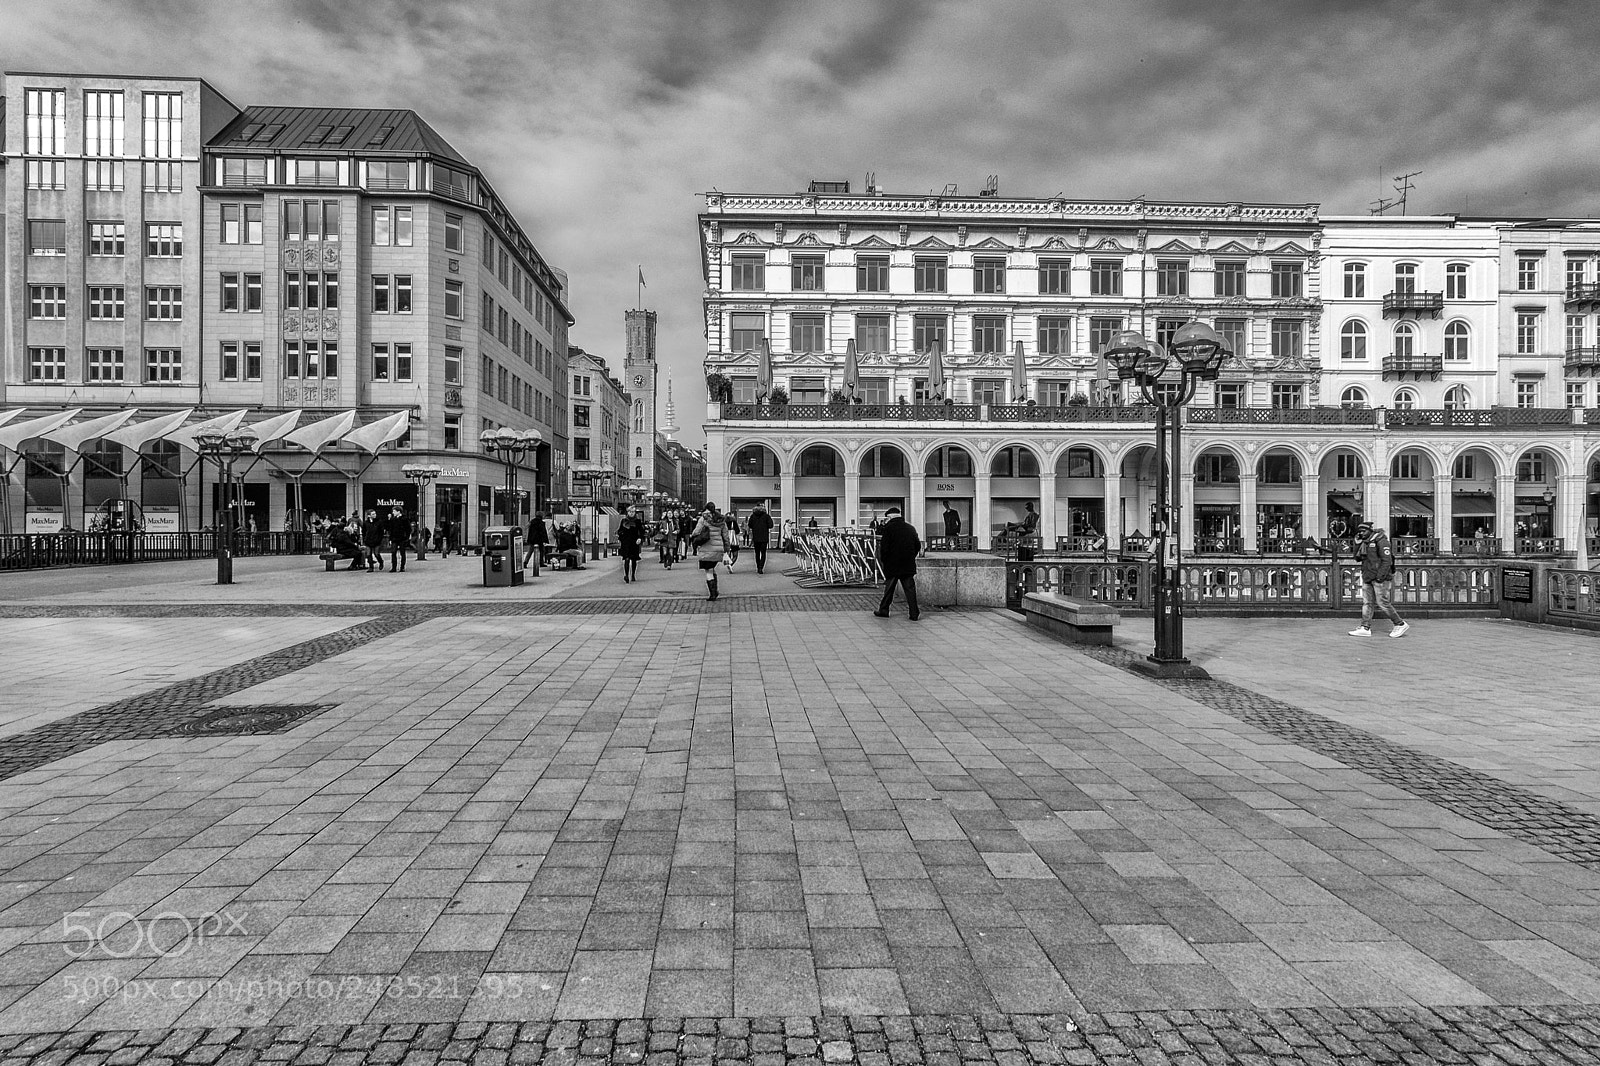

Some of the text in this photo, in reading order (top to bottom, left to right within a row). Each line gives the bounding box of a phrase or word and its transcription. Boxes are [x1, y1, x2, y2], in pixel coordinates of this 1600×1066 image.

[376, 498, 404, 506] MaxMara
[31, 517, 58, 525] MaxMara
[147, 517, 174, 525] MaxMara
